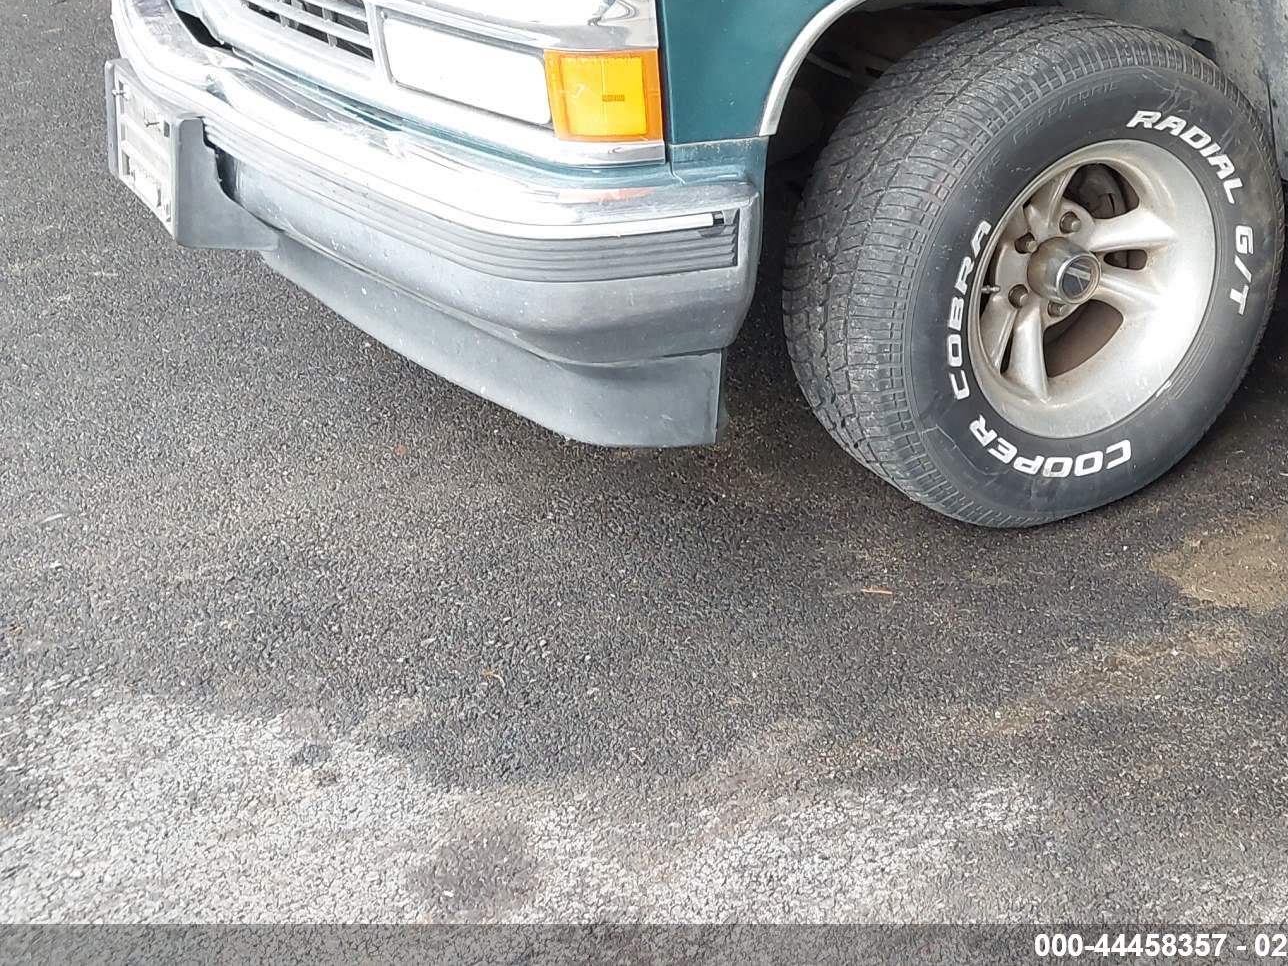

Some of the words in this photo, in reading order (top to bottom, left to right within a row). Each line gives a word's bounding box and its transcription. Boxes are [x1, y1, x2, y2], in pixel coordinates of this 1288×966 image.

[1126, 109, 1249, 205] RADIAL
[1228, 225, 1255, 315] G/T
[947, 219, 993, 401] COBRA
[968, 414, 1133, 479] COOPER
